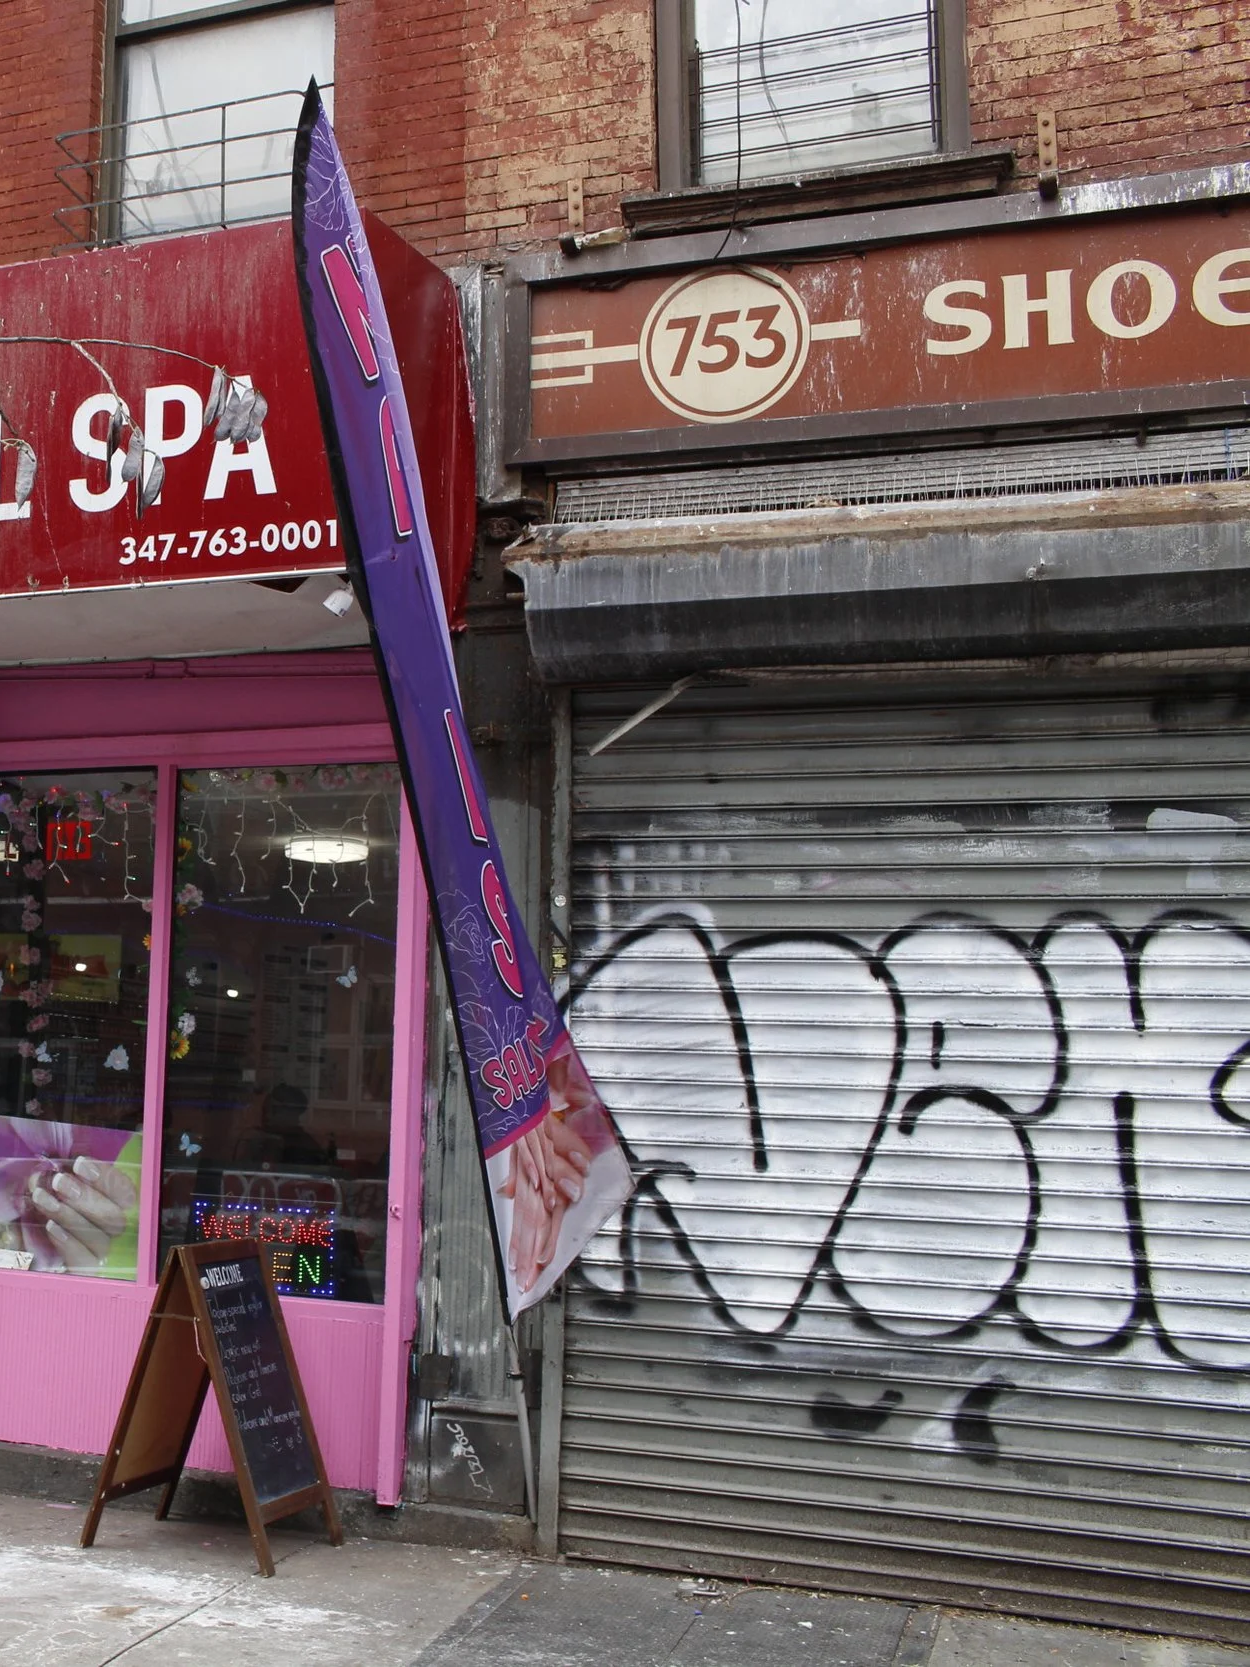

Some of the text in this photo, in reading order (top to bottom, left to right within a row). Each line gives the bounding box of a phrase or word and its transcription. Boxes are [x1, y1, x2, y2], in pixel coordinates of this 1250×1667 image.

[666, 304, 787, 377] 753
[68, 374, 278, 514] SPA
[119, 519, 338, 566] 347-763-0001
[199, 1212, 333, 1247] WELCOME
[206, 1264, 244, 1287] WELCOME
[273, 1252, 320, 1284] EN
